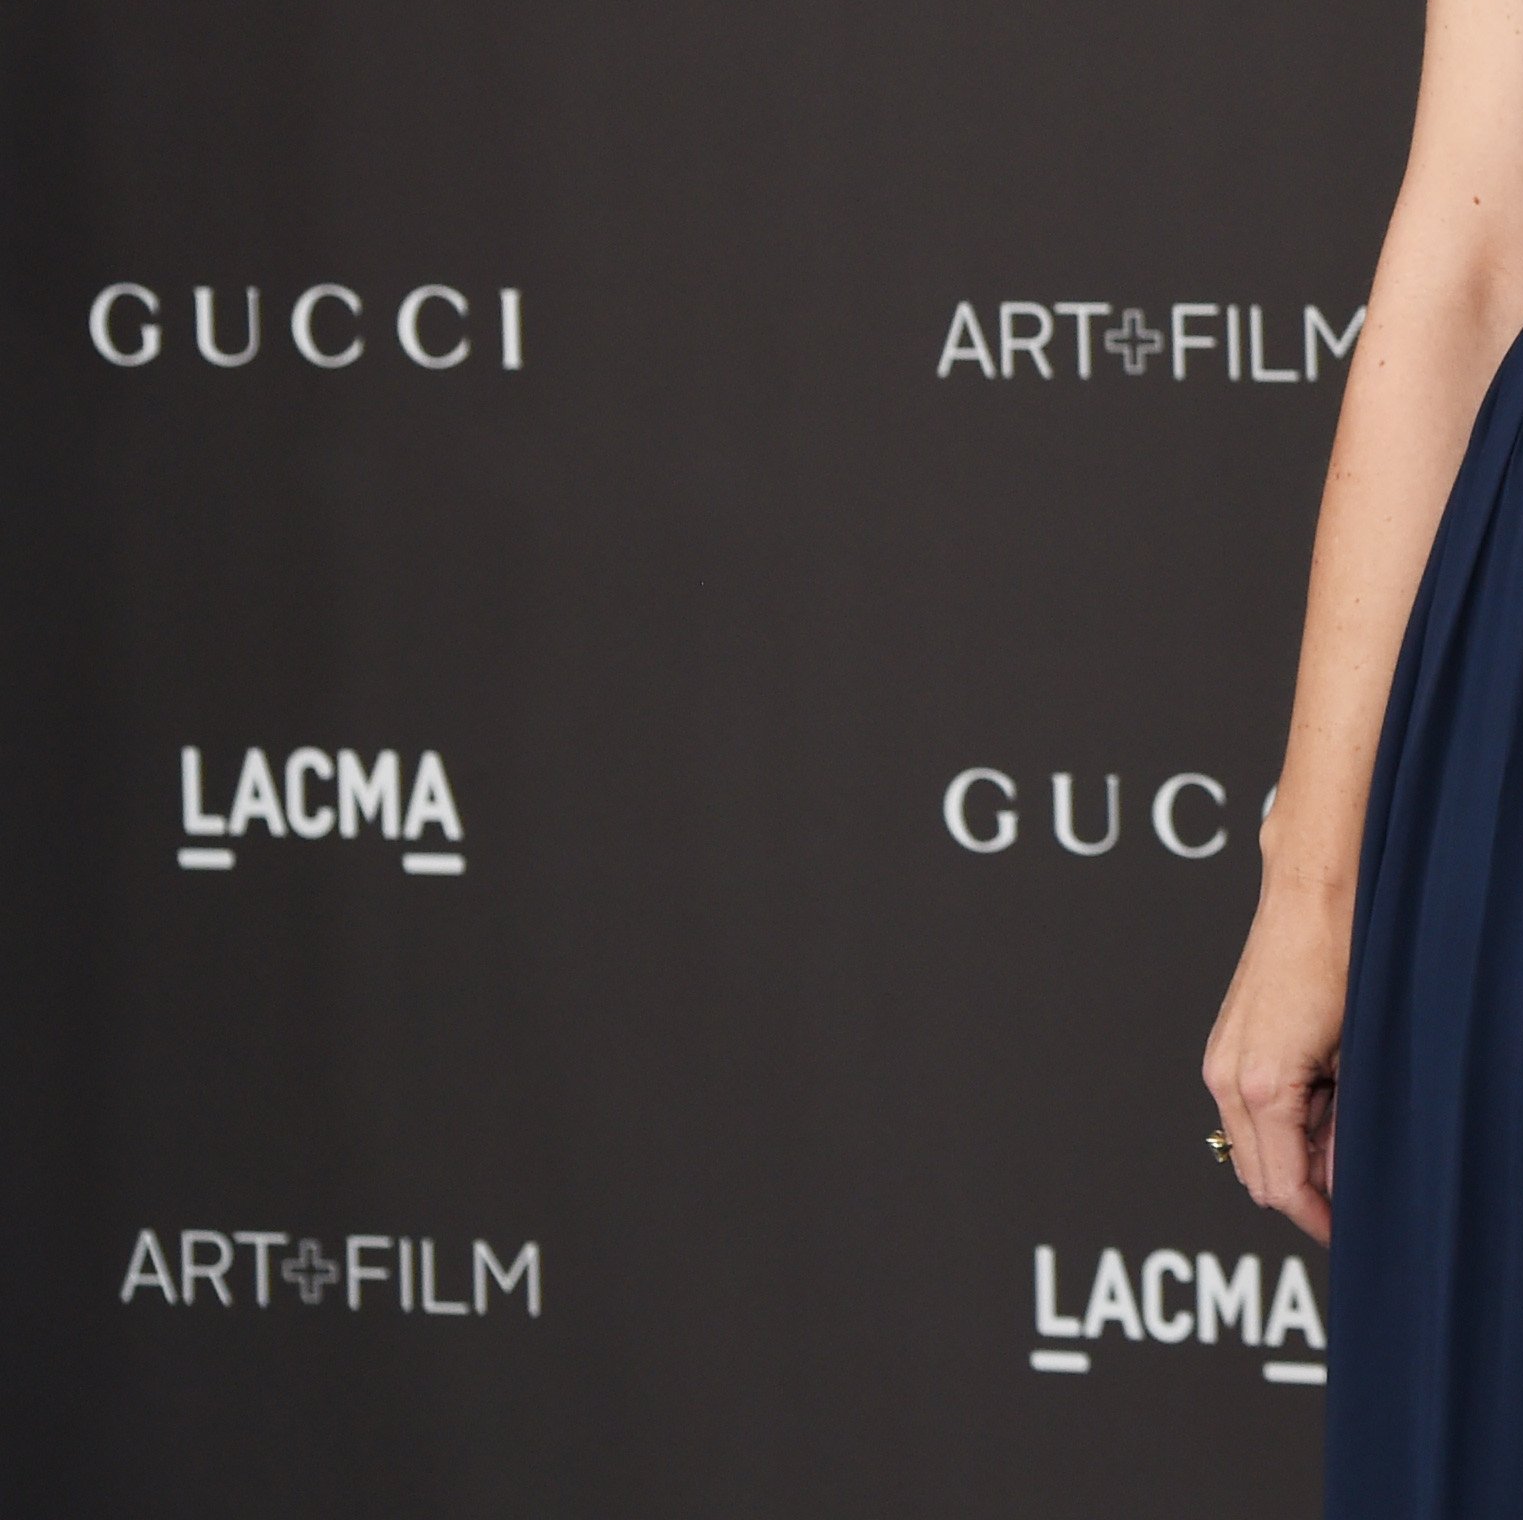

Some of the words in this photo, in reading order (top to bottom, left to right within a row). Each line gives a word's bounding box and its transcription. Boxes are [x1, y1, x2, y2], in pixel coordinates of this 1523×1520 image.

[88, 283, 523, 371] GUCCI
[181, 746, 463, 841] LACMA
[943, 767, 1277, 859] GUC
[120, 1229, 541, 1318] ART+FILM
[1034, 1245, 1326, 1349] LACMA
